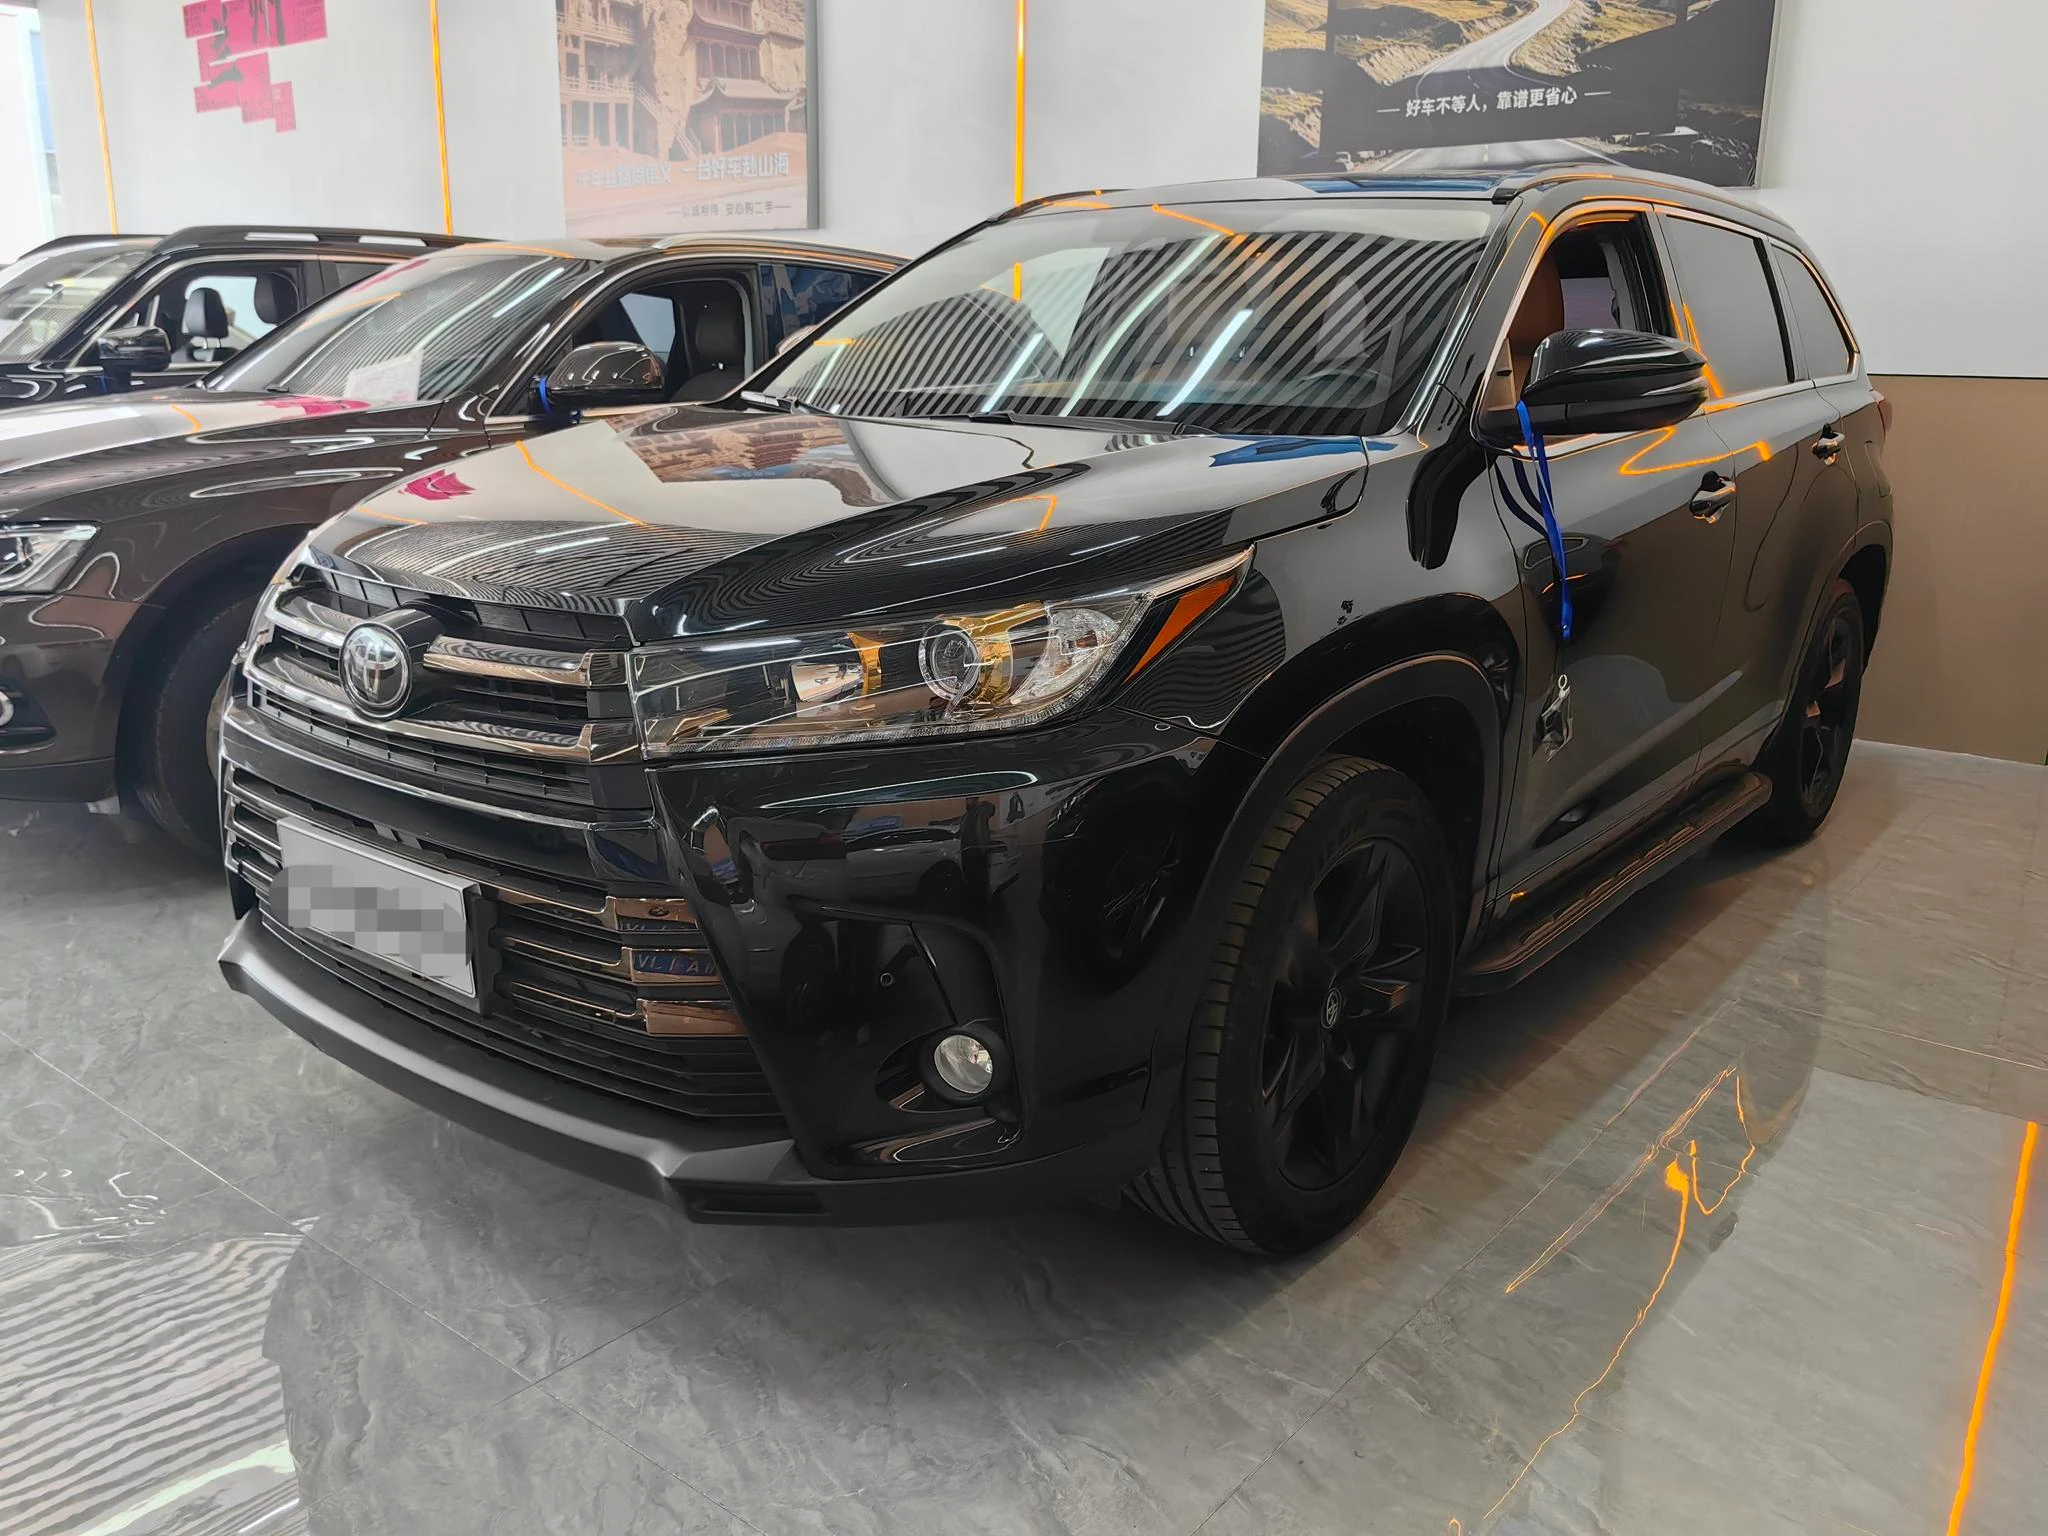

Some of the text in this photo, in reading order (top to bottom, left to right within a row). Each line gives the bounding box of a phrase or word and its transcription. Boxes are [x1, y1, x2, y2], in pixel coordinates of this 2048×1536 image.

[1405, 86, 1578, 118] 好车不等人，靠谱更省心
[681, 152, 790, 181] 一台好车赴山海
